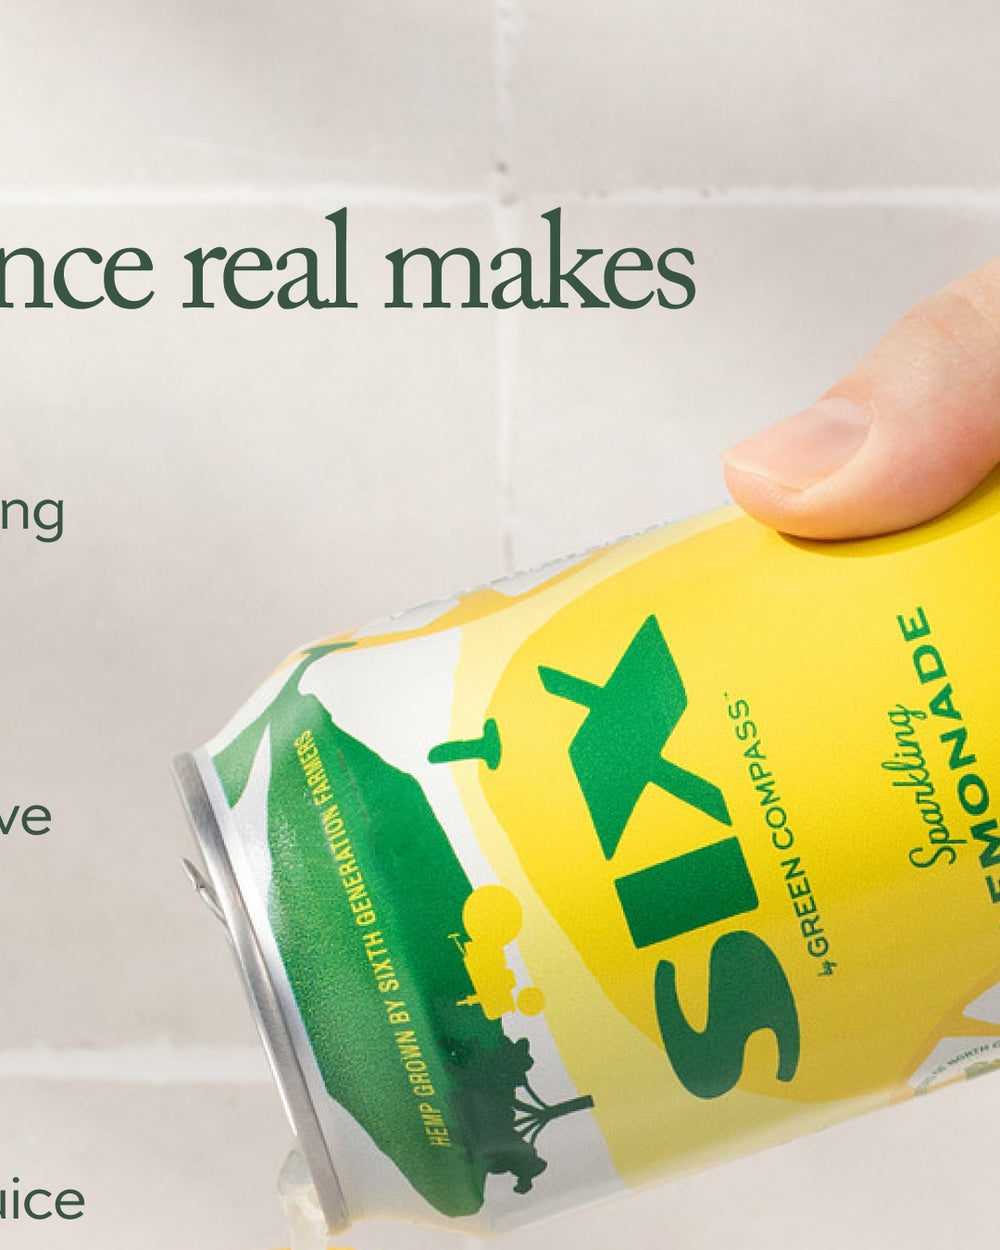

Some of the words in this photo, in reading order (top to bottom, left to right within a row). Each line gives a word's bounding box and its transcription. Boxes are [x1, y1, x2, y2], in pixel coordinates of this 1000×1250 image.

[293, 728, 332, 806] FARMERS
[881, 704, 967, 869] Sparkling
[320, 805, 376, 926] GENERATION
[537, 613, 801, 1099] SIX
[780, 857, 829, 957] GREEN
[362, 930, 400, 992] SIXTH
[385, 998, 410, 1024] BY
[394, 1030, 435, 1098] GROWN
[418, 1103, 452, 1148] HEMP
